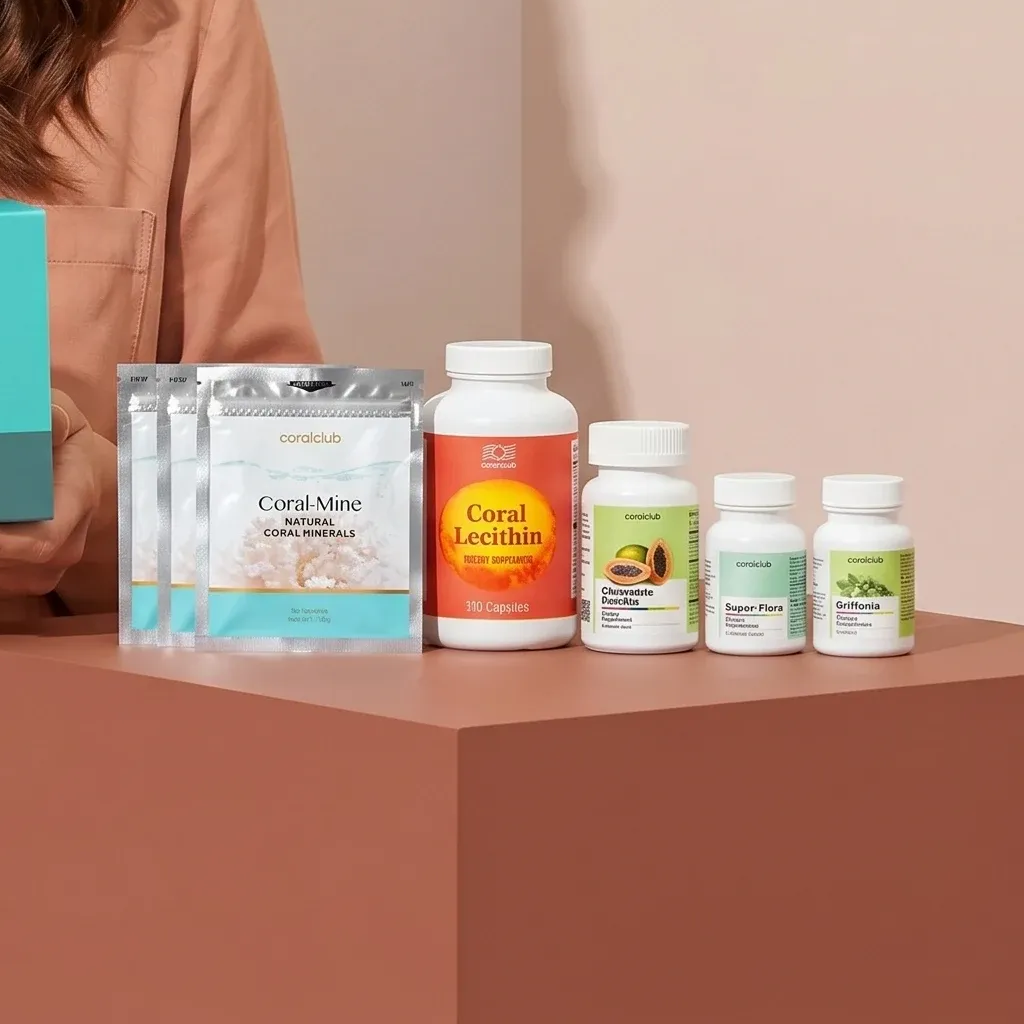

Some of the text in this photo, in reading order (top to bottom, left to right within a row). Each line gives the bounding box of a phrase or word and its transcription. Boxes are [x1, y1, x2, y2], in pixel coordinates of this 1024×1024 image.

[279, 431, 342, 444] coralclub
[258, 494, 363, 512] Coral-Mine
[466, 503, 527, 523] Coral
[284, 517, 336, 527] NATURAL
[263, 528, 356, 538] CORAL MINERALS
[454, 526, 543, 546] Lecithin
[835, 600, 881, 611] Griffonia
